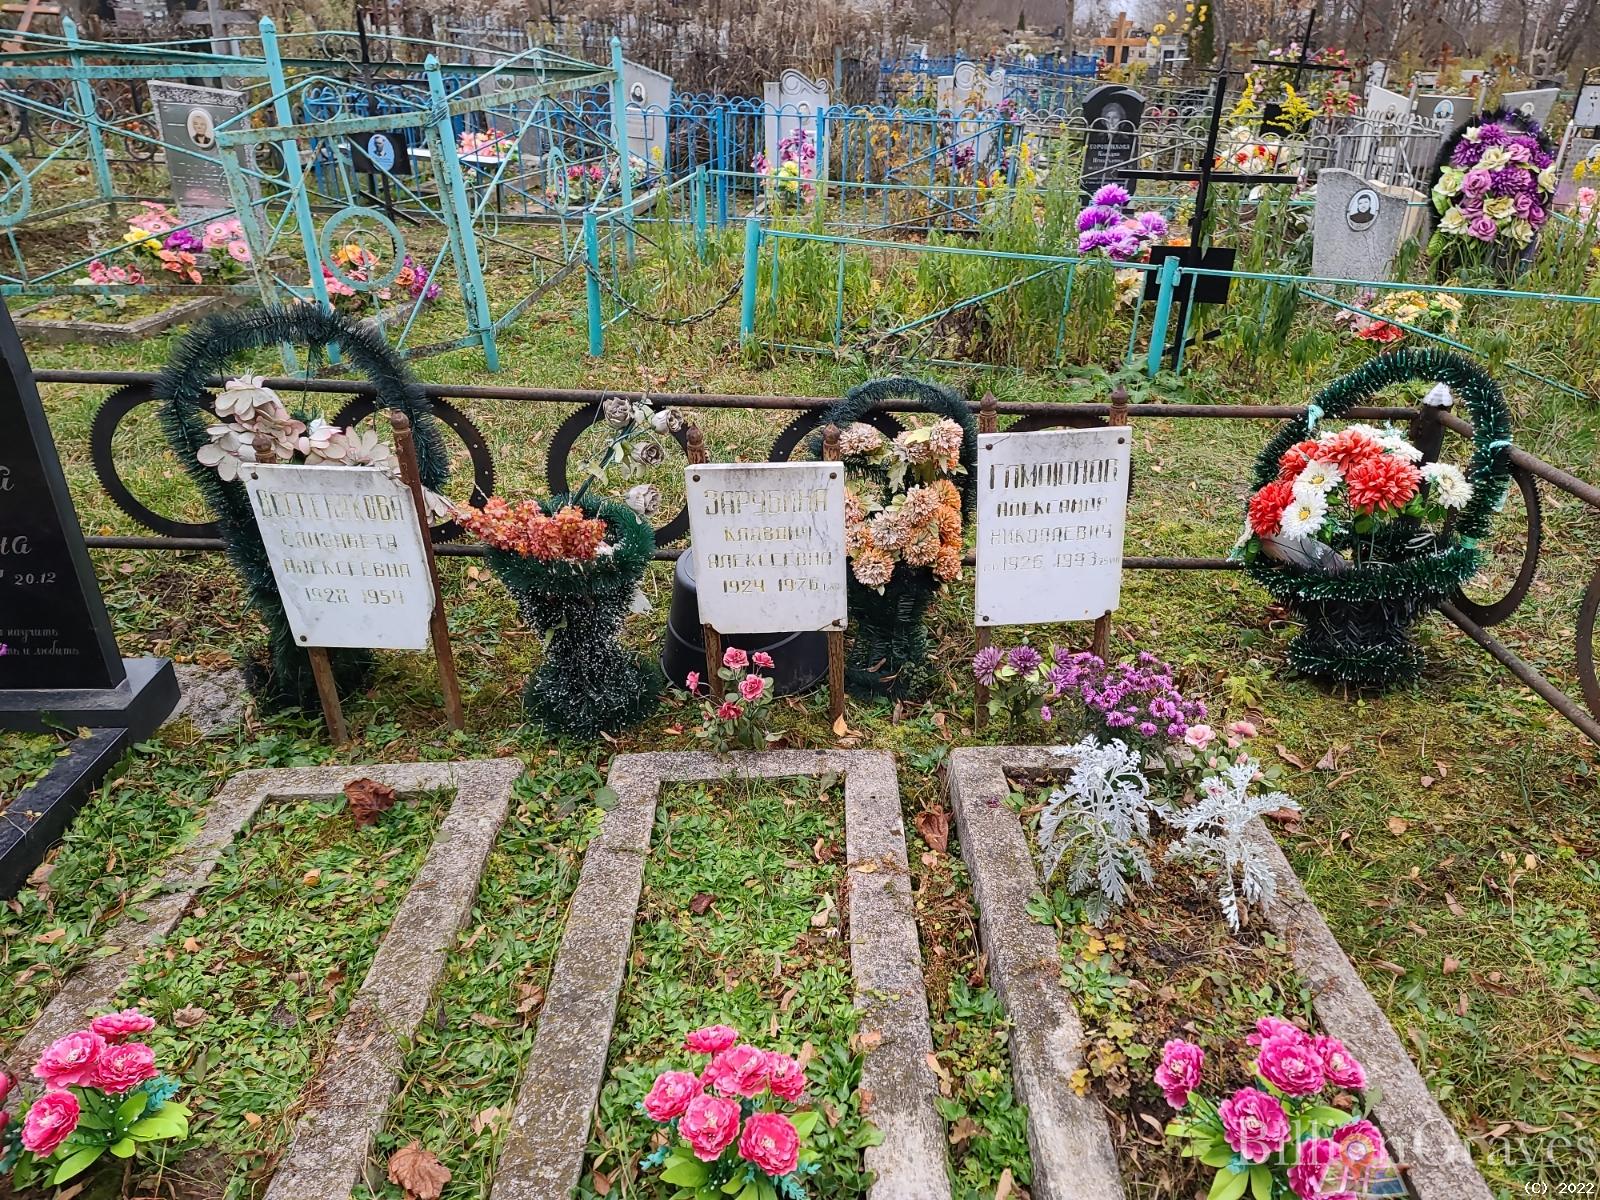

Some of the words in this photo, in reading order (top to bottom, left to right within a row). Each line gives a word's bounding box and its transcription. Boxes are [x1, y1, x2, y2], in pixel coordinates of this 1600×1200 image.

[704, 489, 828, 515] ЗАРУБИНА
[997, 498, 1108, 518] АЛЕКСАНДР
[281, 529, 398, 551] ЕЛИЗАВЕТА
[990, 524, 1112, 545] НИКОЛАЕВИЧ
[283, 558, 412, 578] АЛЕКСЕЕВНА
[708, 552, 832, 569] АЛЕКСЕЕВНА
[723, 579, 765, 593] 1924
